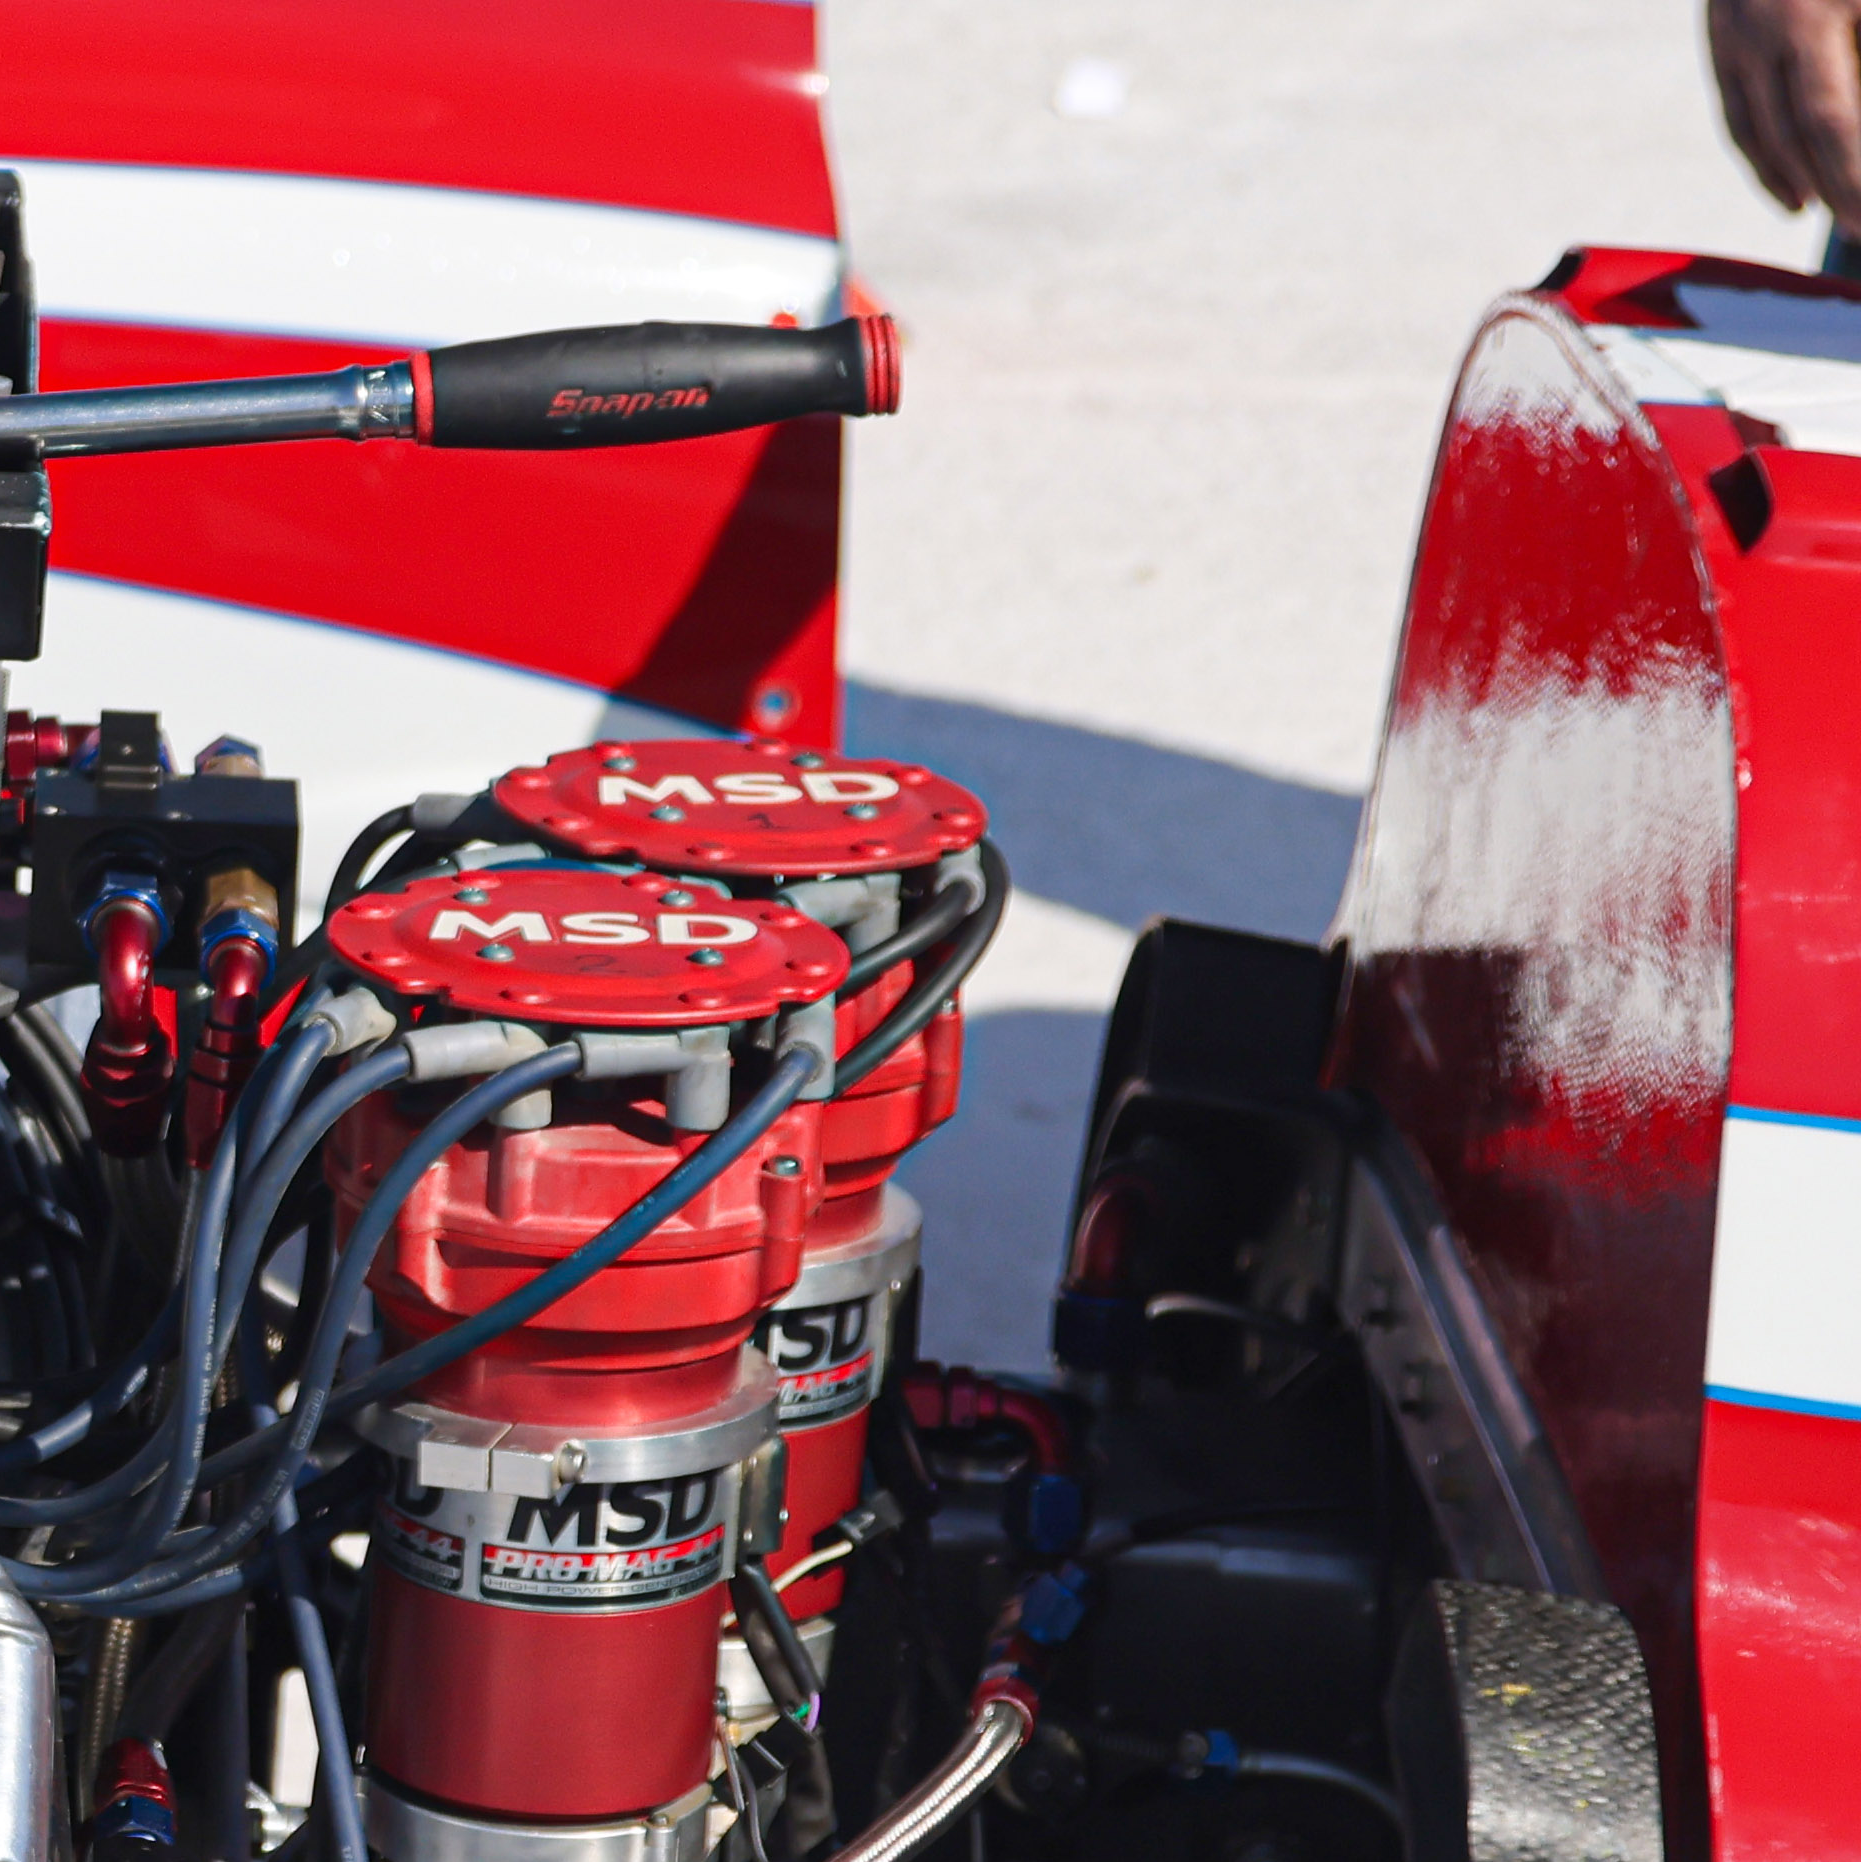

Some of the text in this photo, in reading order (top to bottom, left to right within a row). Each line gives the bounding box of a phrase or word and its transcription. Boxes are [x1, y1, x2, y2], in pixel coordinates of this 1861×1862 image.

[598, 772, 899, 806] MSD
[427, 909, 759, 946] MSD
[754, 1298, 870, 1370] SD
[506, 1471, 717, 1547] MSD
[486, 1577, 541, 1594] HIGH
[546, 1583, 626, 1597] POWER
